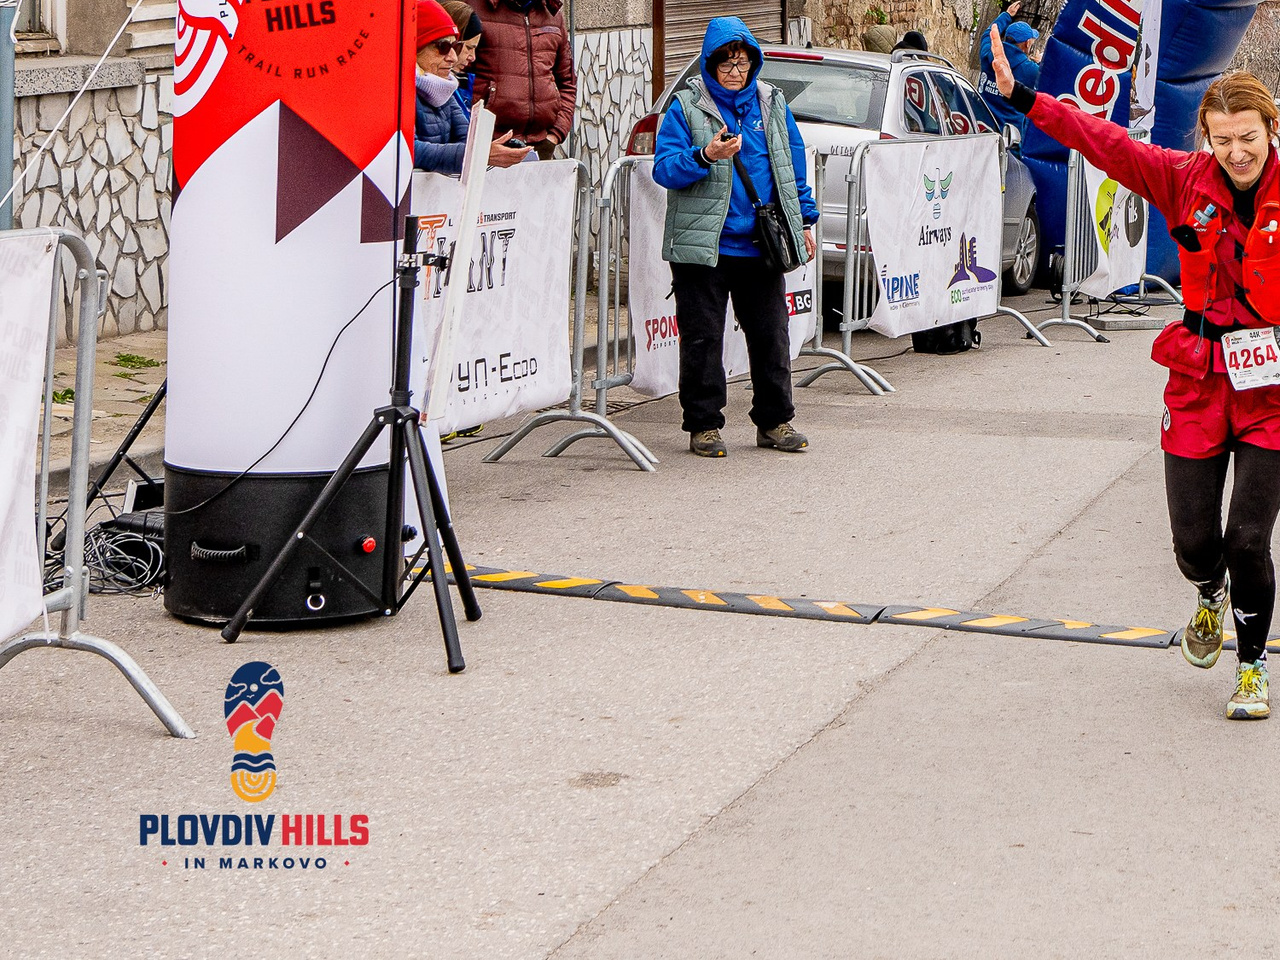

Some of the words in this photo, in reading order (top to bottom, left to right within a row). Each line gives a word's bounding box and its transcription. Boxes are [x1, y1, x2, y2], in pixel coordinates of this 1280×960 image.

[265, 0, 336, 33] HILLS
[237, 44, 282, 78] TRAIL
[293, 63, 330, 80] RUN
[337, 30, 370, 66] RACE
[484, 211, 517, 223] TRANSPORT
[918, 224, 952, 247] Airways
[881, 273, 920, 301] LPINE
[950, 288, 962, 305] ECO
[645, 314, 678, 352] SPON
[1228, 344, 1279, 371] 4264
